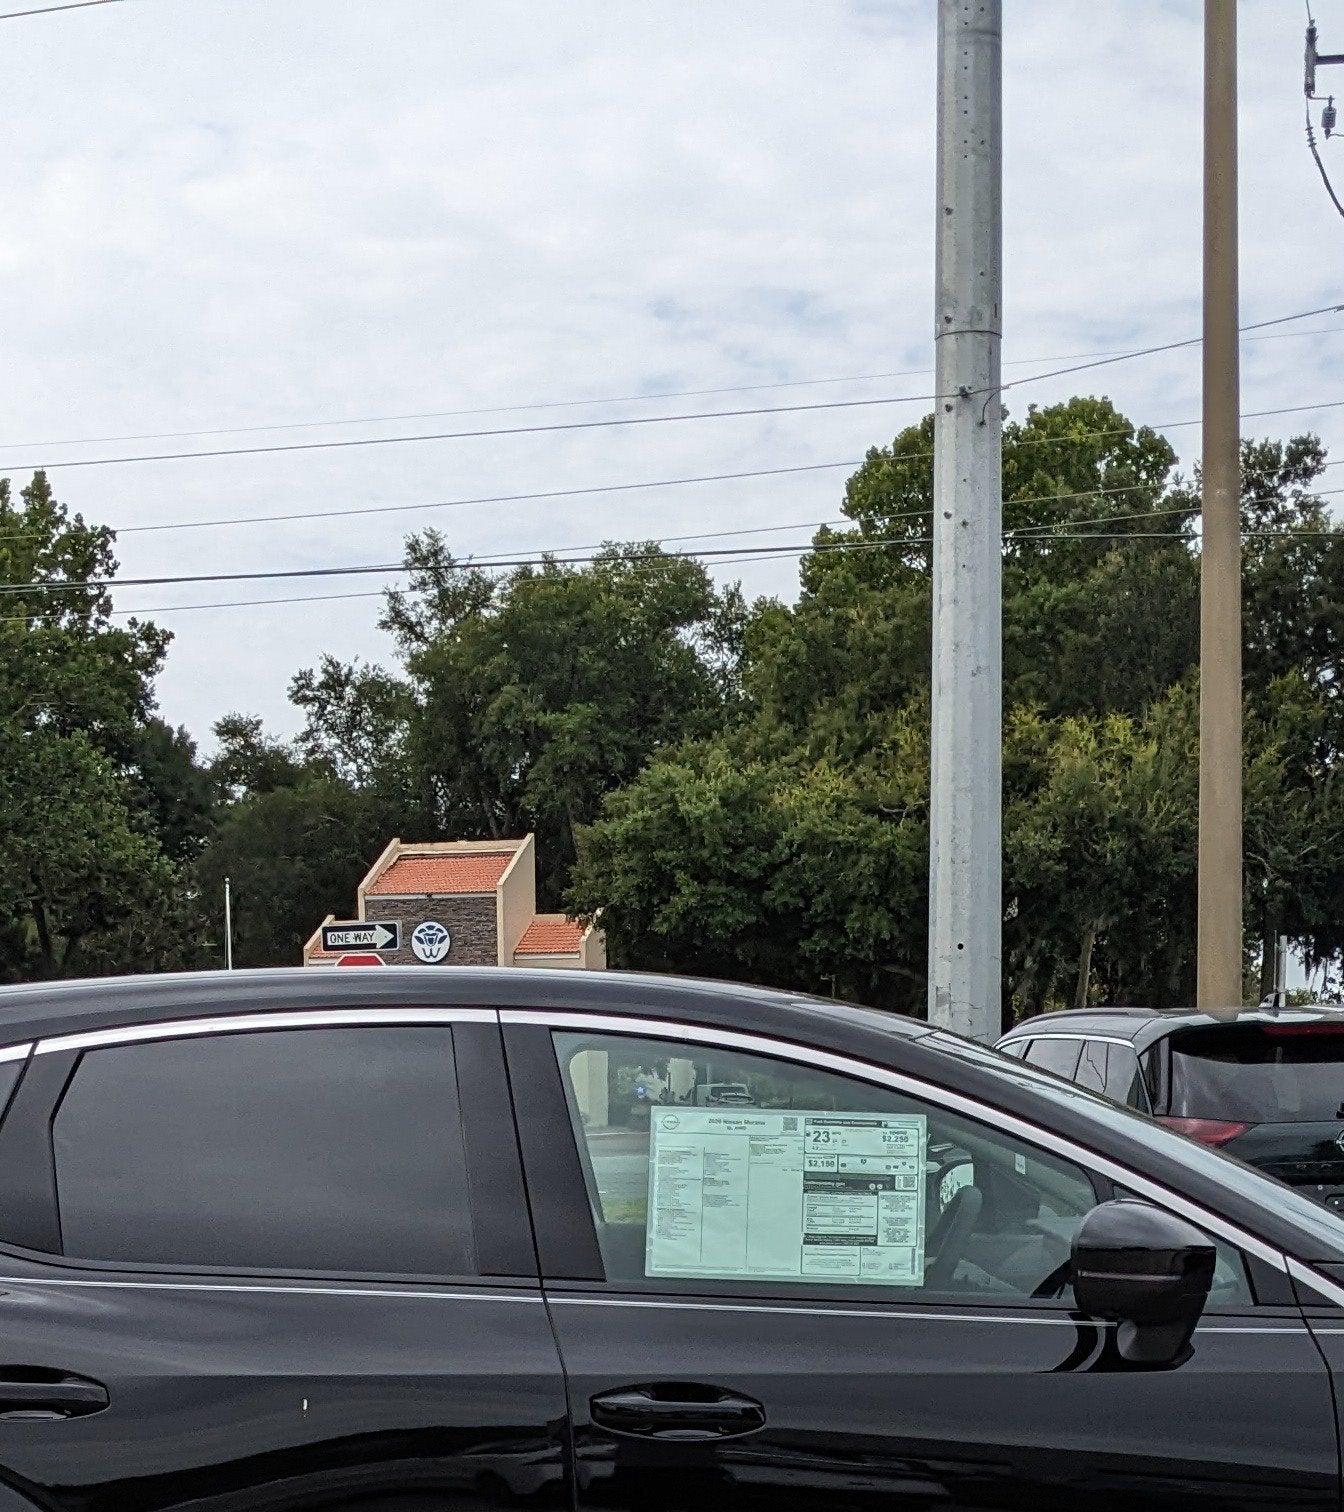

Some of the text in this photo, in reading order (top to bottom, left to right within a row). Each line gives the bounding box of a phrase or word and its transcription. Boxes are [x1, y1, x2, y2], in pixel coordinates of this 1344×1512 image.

[329, 931, 376, 944] ONE WAY
[812, 1130, 831, 1143] 23
